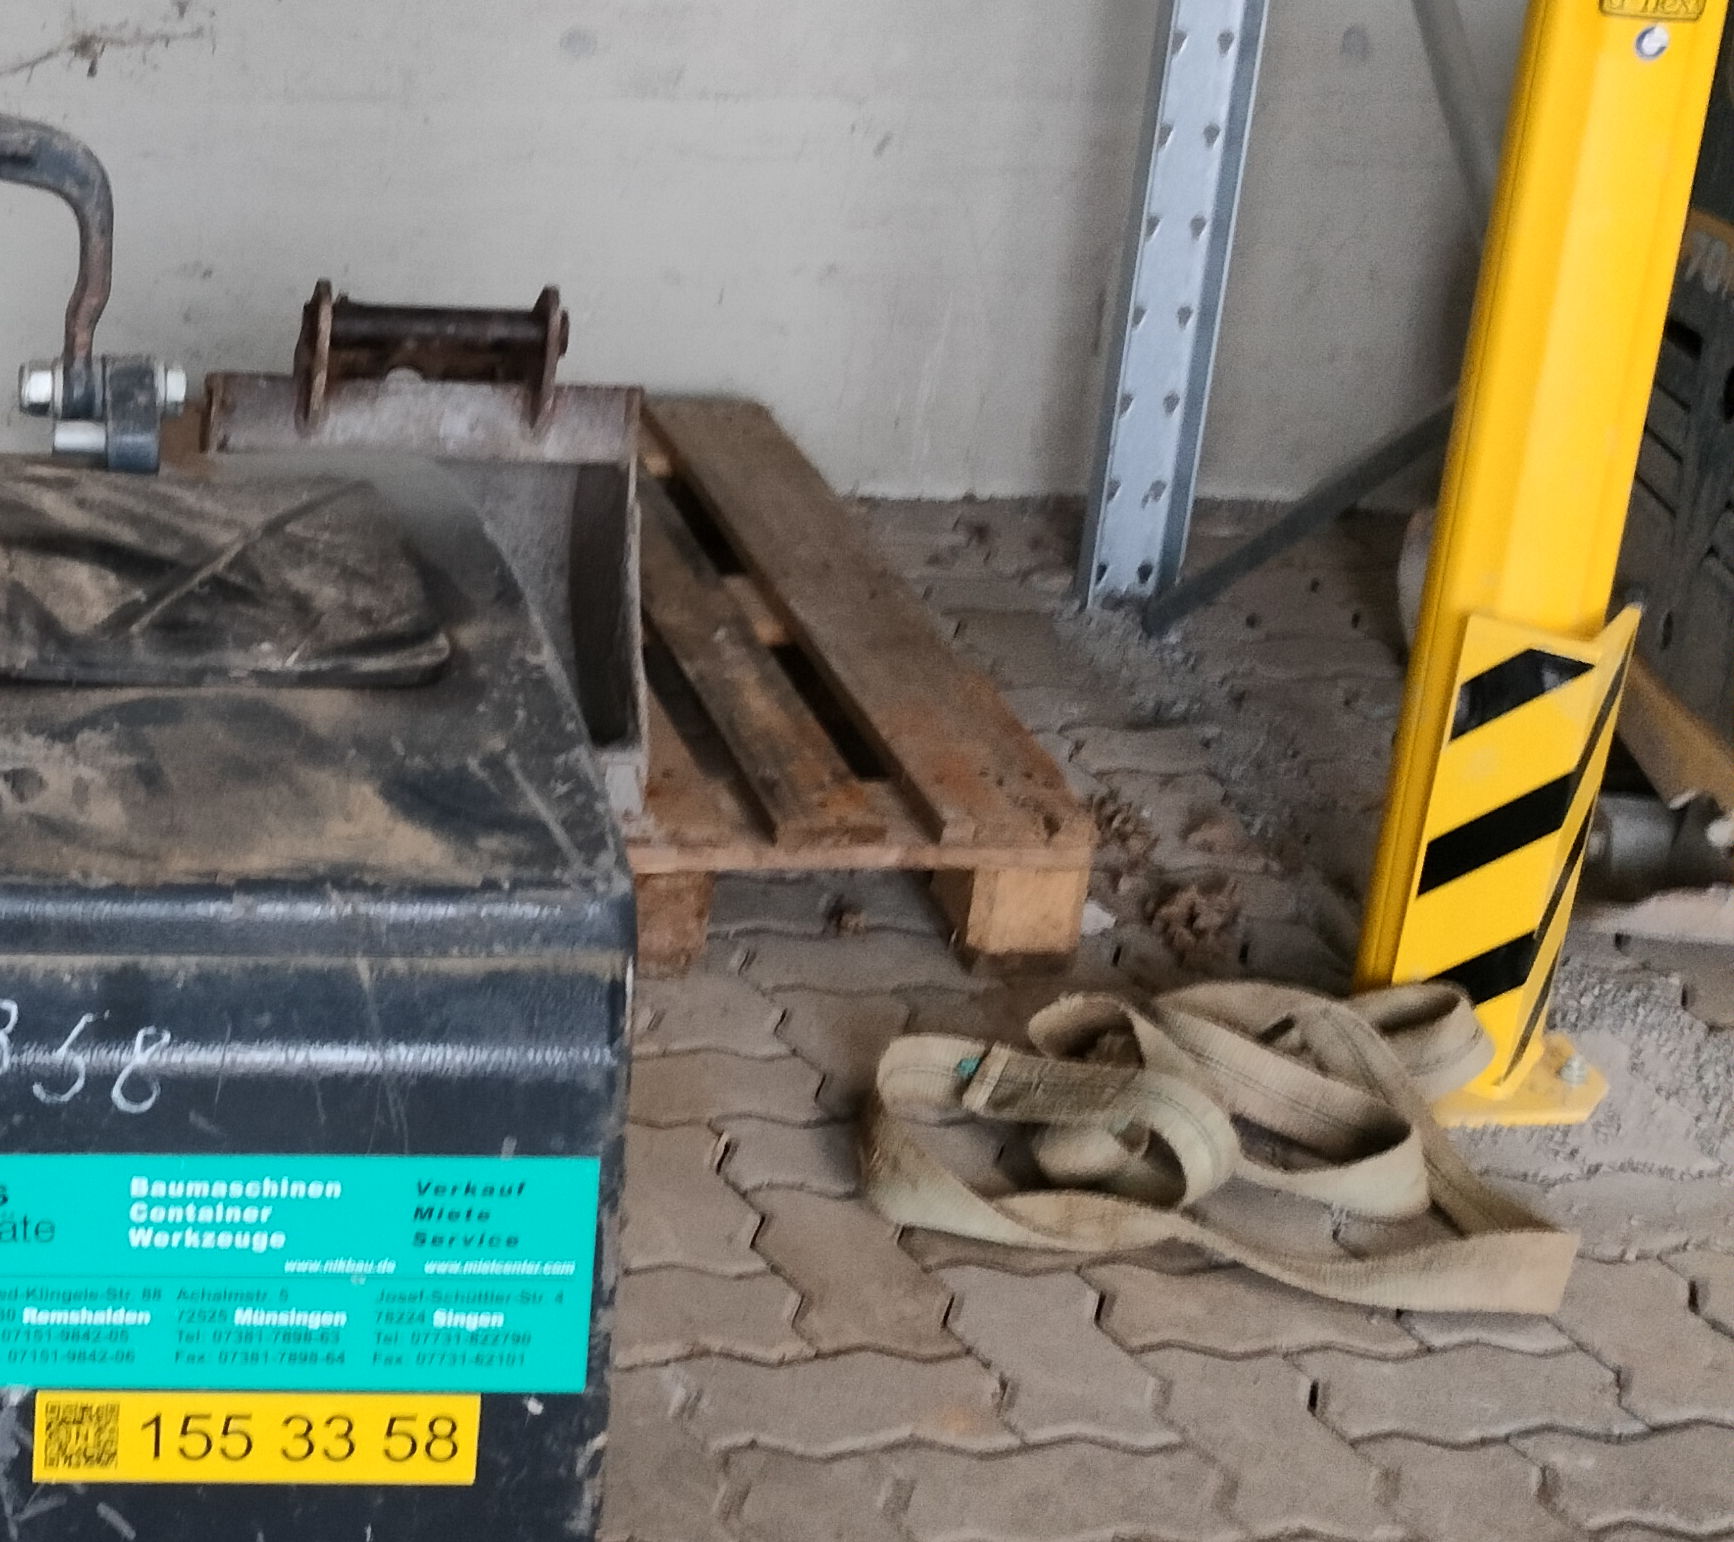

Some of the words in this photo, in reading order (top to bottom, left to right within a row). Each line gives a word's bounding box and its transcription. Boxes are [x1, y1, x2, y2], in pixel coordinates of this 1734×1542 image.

[130, 1175, 342, 1199] Baumaschinen
[416, 1179, 527, 1198] Verkauf
[129, 1202, 273, 1224] Container
[412, 1205, 491, 1223] Miete
[128, 1227, 287, 1253] Werkzeuge
[412, 1230, 520, 1248] Service
[432, 1307, 506, 1332] Singen
[139, 1412, 254, 1462] 155
[280, 1413, 357, 1463] 33
[382, 1413, 460, 1464] 58
